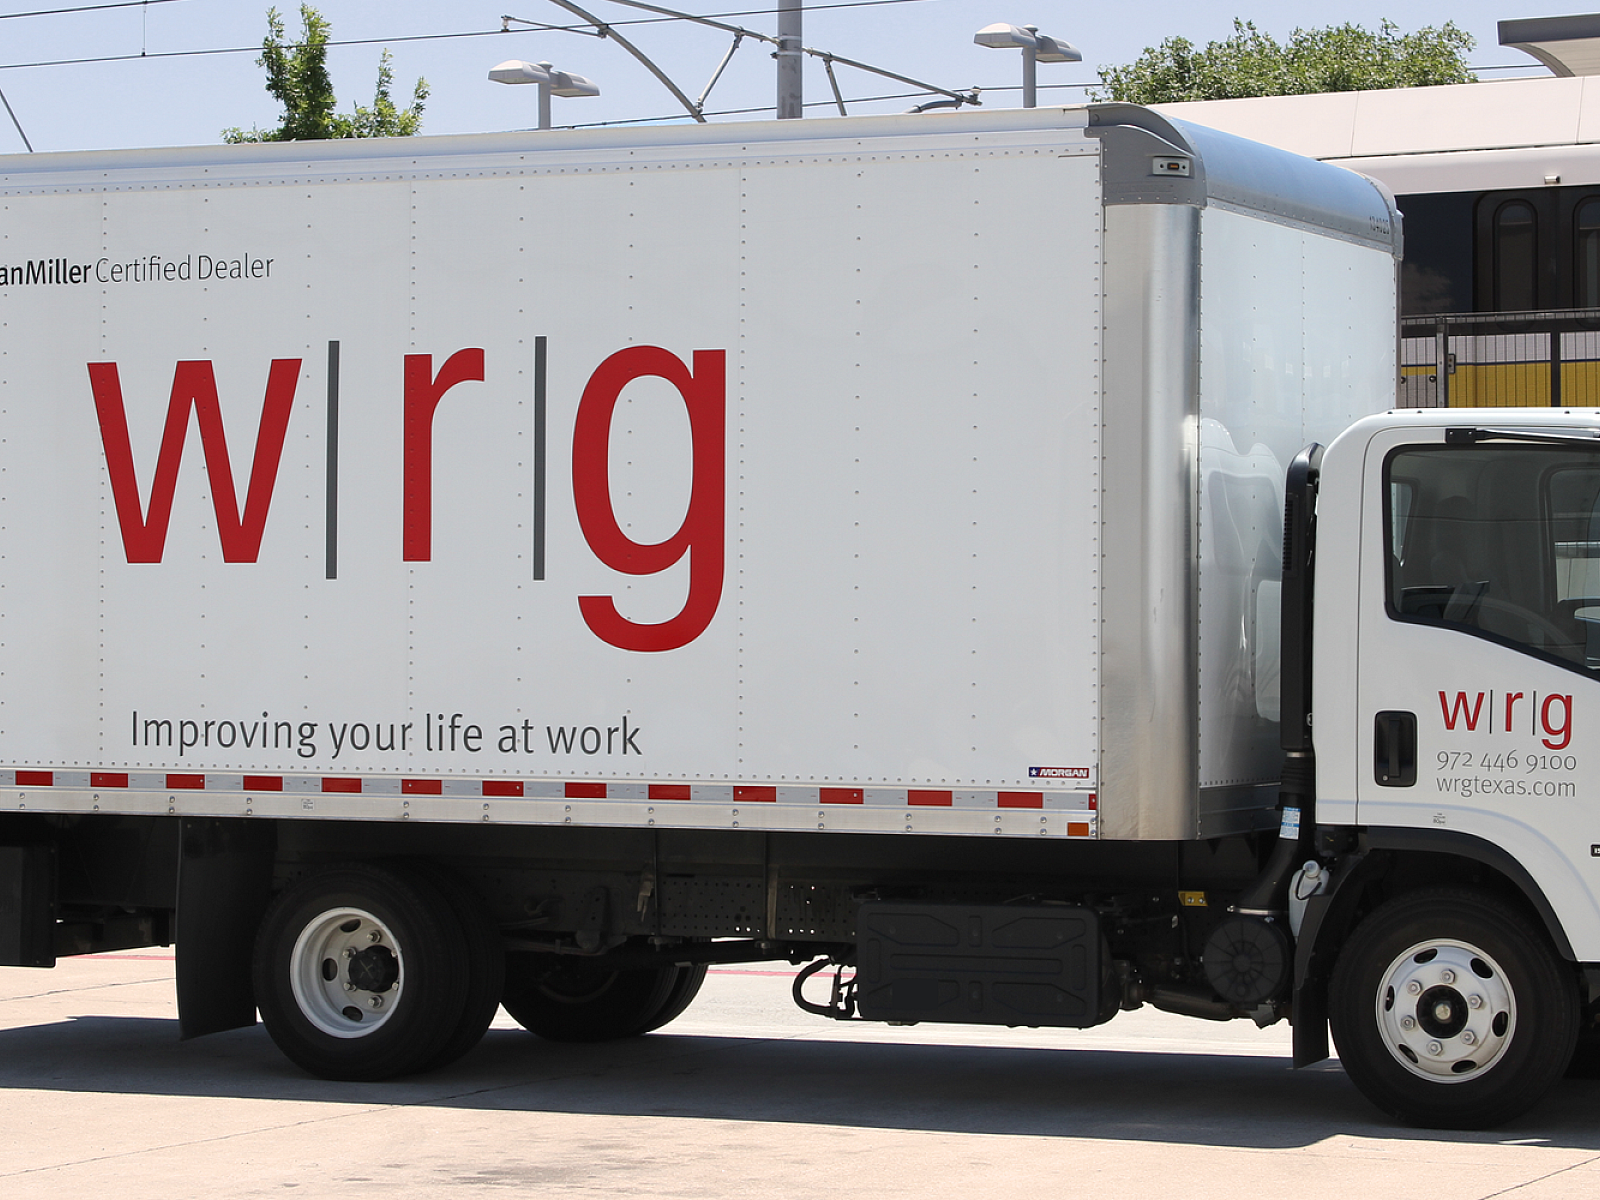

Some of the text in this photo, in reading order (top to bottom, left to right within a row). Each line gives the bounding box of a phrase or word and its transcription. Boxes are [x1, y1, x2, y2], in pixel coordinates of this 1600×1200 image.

[95, 254, 191, 283] Certified
[198, 252, 275, 281] Dealer
[132, 710, 643, 760] Improving your life at work
[1040, 768, 1088, 777] MORGAN
[1436, 749, 1577, 775] 972 446 9100
[1436, 775, 1576, 798] wrgtexas.com
